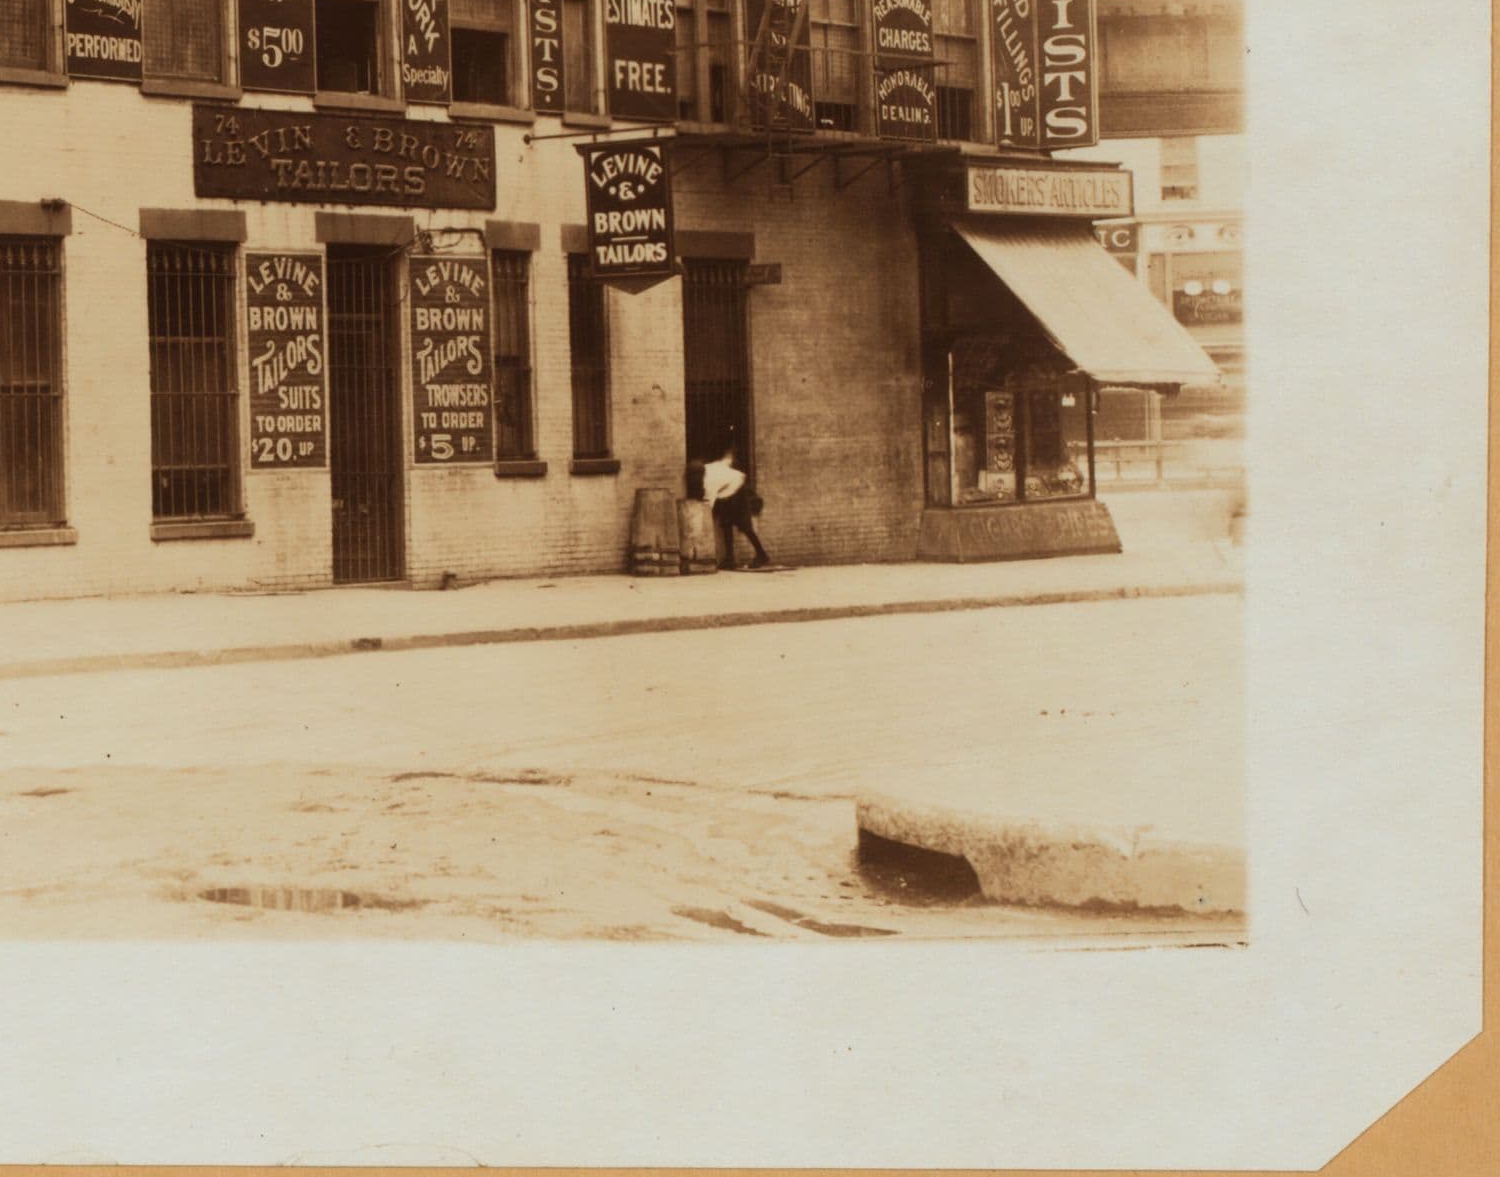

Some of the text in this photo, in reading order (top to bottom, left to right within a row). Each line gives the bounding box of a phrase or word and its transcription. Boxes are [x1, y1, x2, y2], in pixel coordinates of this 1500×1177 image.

[66, 32, 142, 63] PERFORMED
[407, 35, 419, 57] A
[878, 26, 932, 53] CHARGES.
[402, 63, 449, 92] Specialty
[613, 58, 672, 94] FREE.
[877, 69, 936, 106] HONORABLE
[213, 113, 241, 135] 74
[881, 103, 932, 125] DEALING.
[344, 125, 364, 150] &
[371, 126, 491, 182] BROWN
[268, 157, 427, 195] TAILORS
[590, 152, 663, 188] LEVINE
[1050, 176, 1121, 209] ARTICLES
[594, 207, 667, 235] BROWN
[595, 241, 668, 265] TAILORS
[249, 256, 321, 297] LEVINE
[414, 261, 486, 298] LEVINE
[275, 282, 293, 302] &
[444, 284, 461, 304] &
[249, 305, 318, 331] BROWN
[415, 307, 484, 331] BROWN
[251, 333, 323, 395] TAILORS
[416, 335, 483, 385] TAILORS
[277, 385, 322, 410] SUITS
[425, 383, 488, 407] TROWSERS
[256, 414, 322, 433] TO ORDER
[421, 411, 484, 429] TO ORDER
[299, 440, 315, 457] UP
